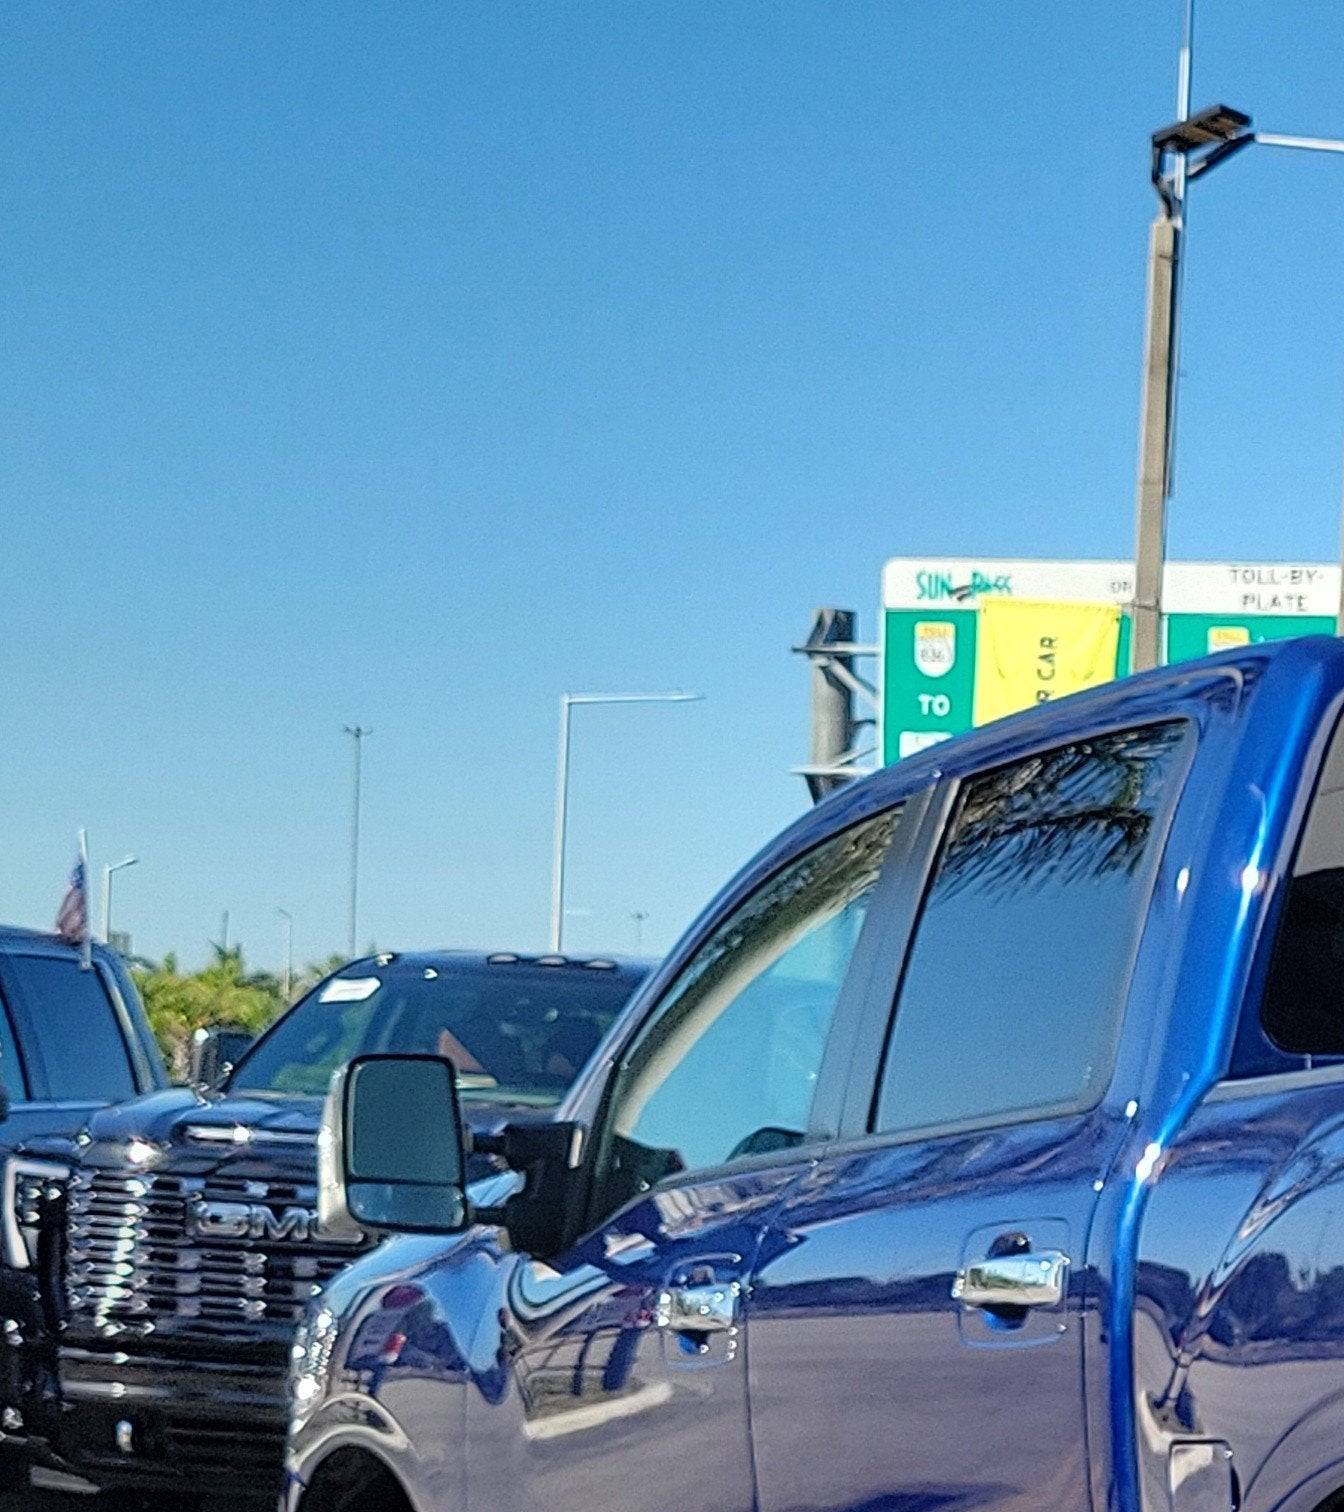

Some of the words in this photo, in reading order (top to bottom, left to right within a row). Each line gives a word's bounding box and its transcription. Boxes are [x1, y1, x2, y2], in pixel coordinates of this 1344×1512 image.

[916, 570, 951, 600] SUN
[1242, 594, 1308, 612] PLATE
[1036, 636, 1058, 681] CAR
[918, 693, 951, 717] TO
